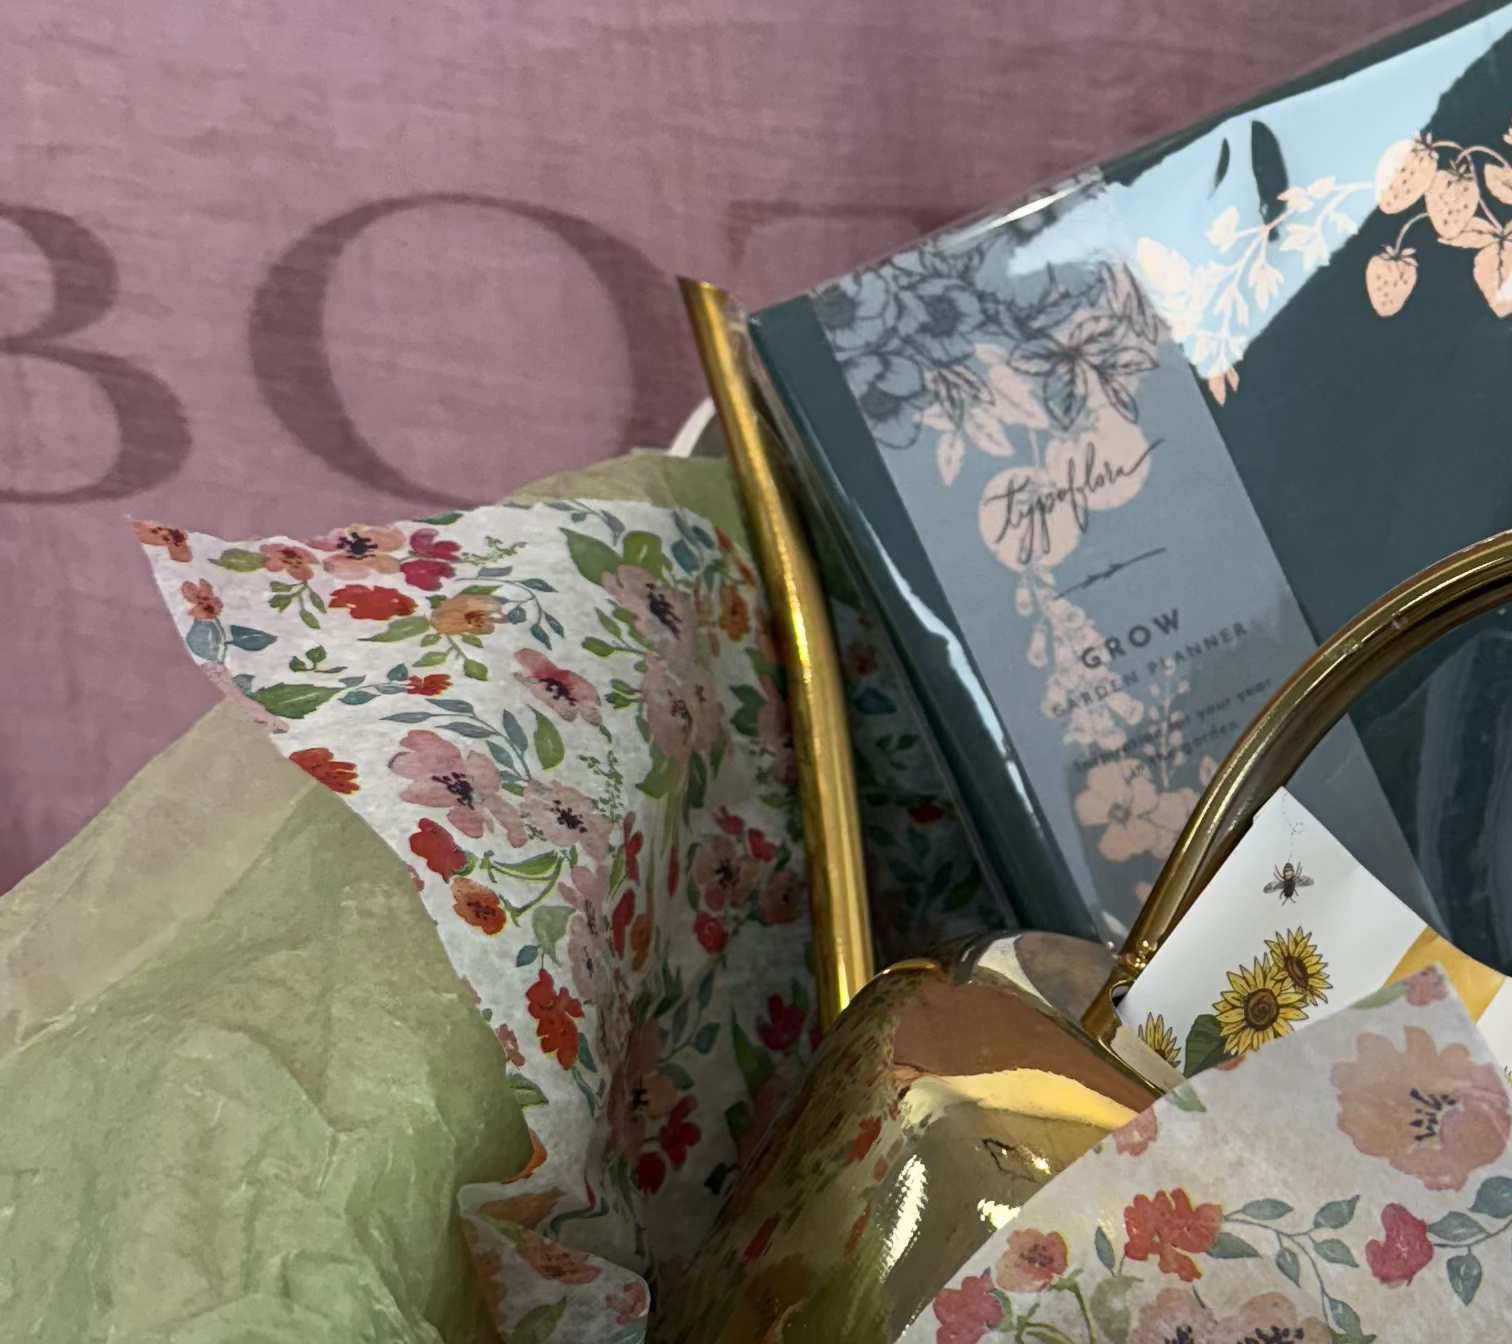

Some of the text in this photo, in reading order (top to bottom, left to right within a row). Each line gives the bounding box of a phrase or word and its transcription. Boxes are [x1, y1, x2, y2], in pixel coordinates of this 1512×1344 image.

[1052, 623, 1247, 717] GARDEN PLANNER
[1082, 609, 1179, 669] GROW
